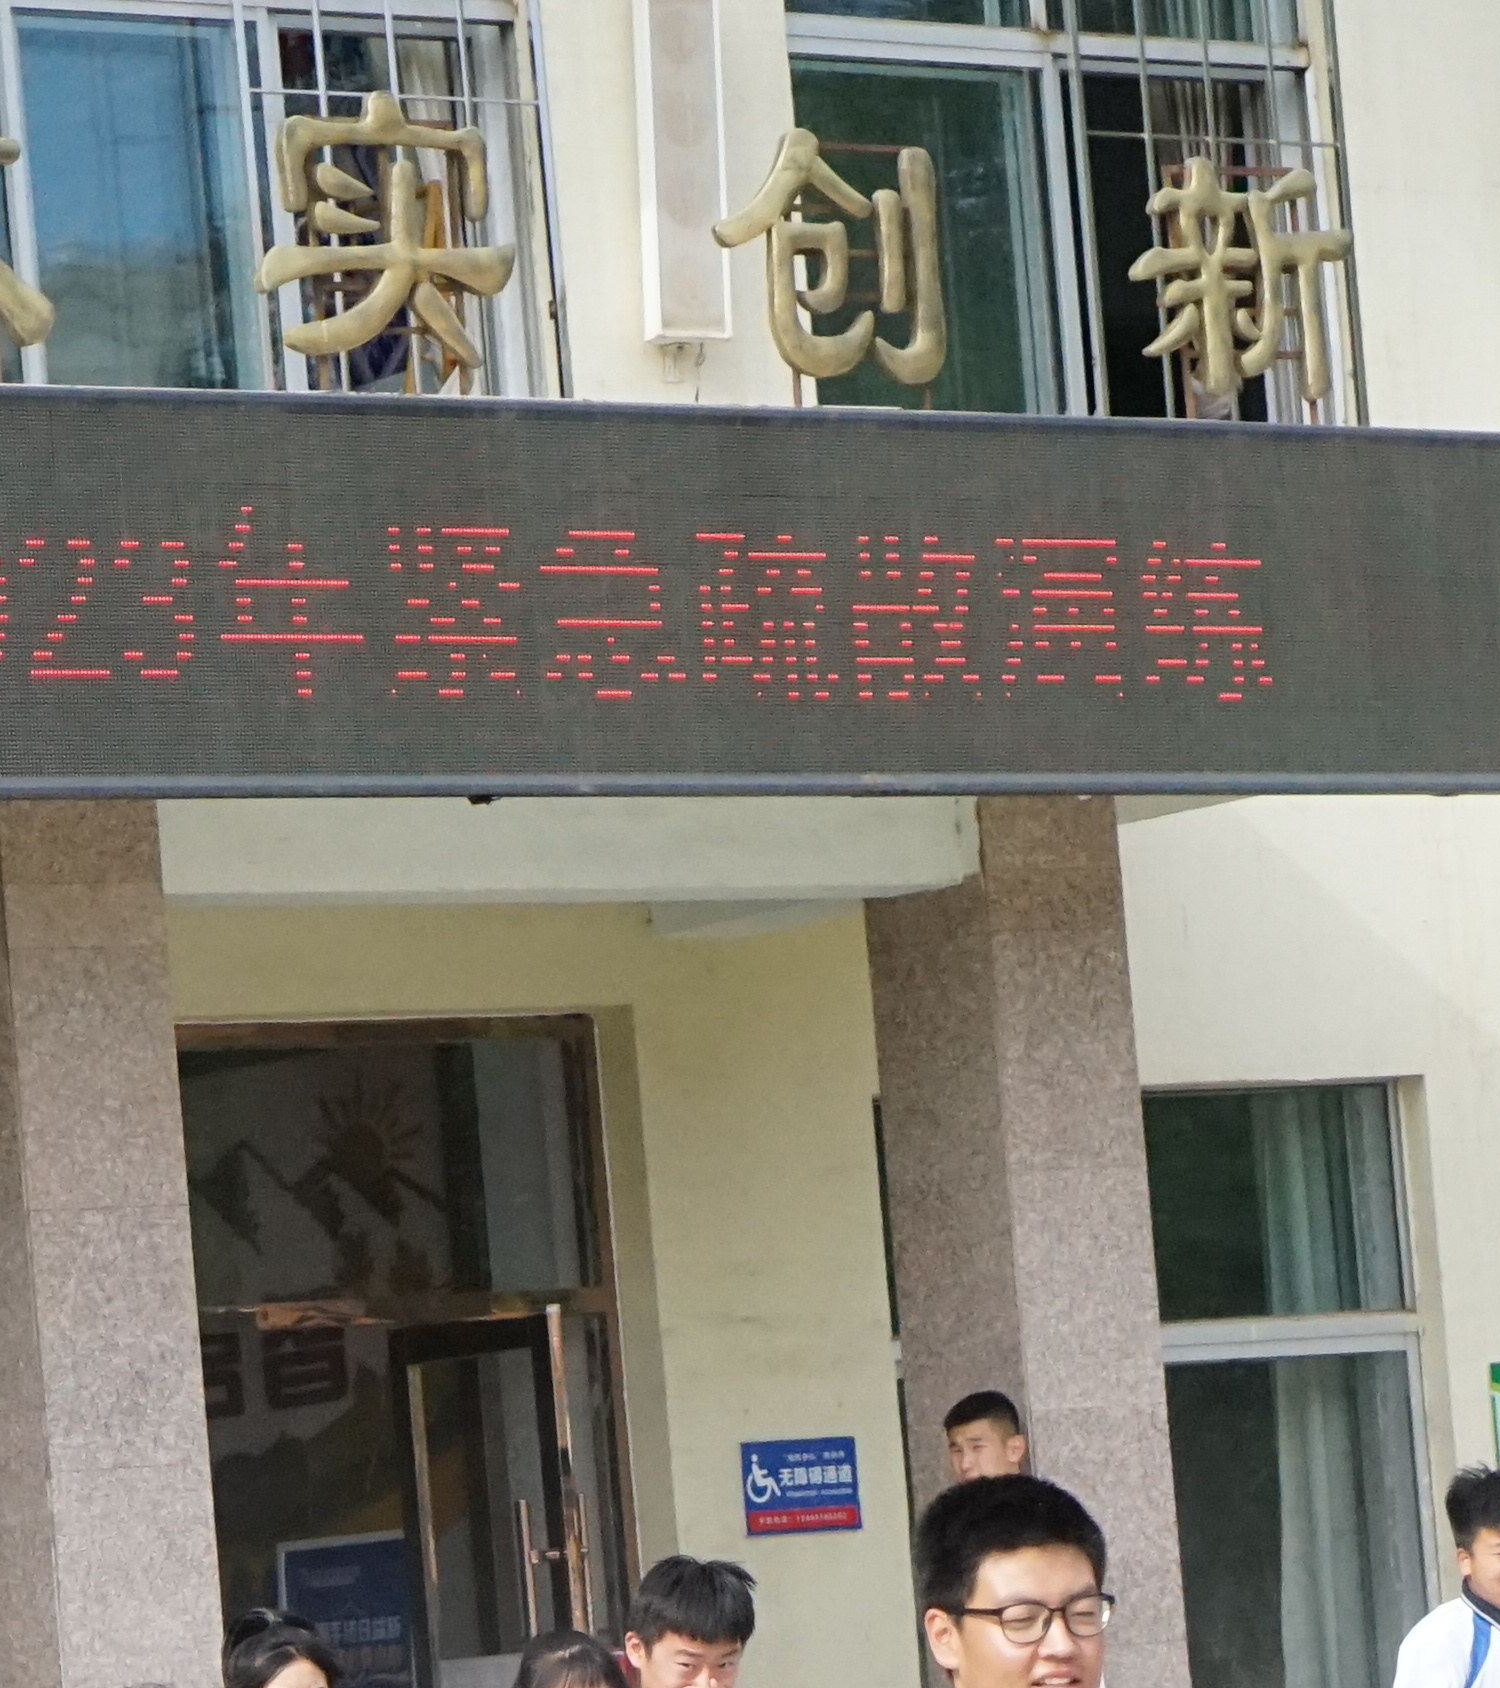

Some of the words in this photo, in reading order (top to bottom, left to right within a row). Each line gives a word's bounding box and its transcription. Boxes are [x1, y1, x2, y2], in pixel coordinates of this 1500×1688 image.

[778, 1464, 853, 1487] 无障碍通道
